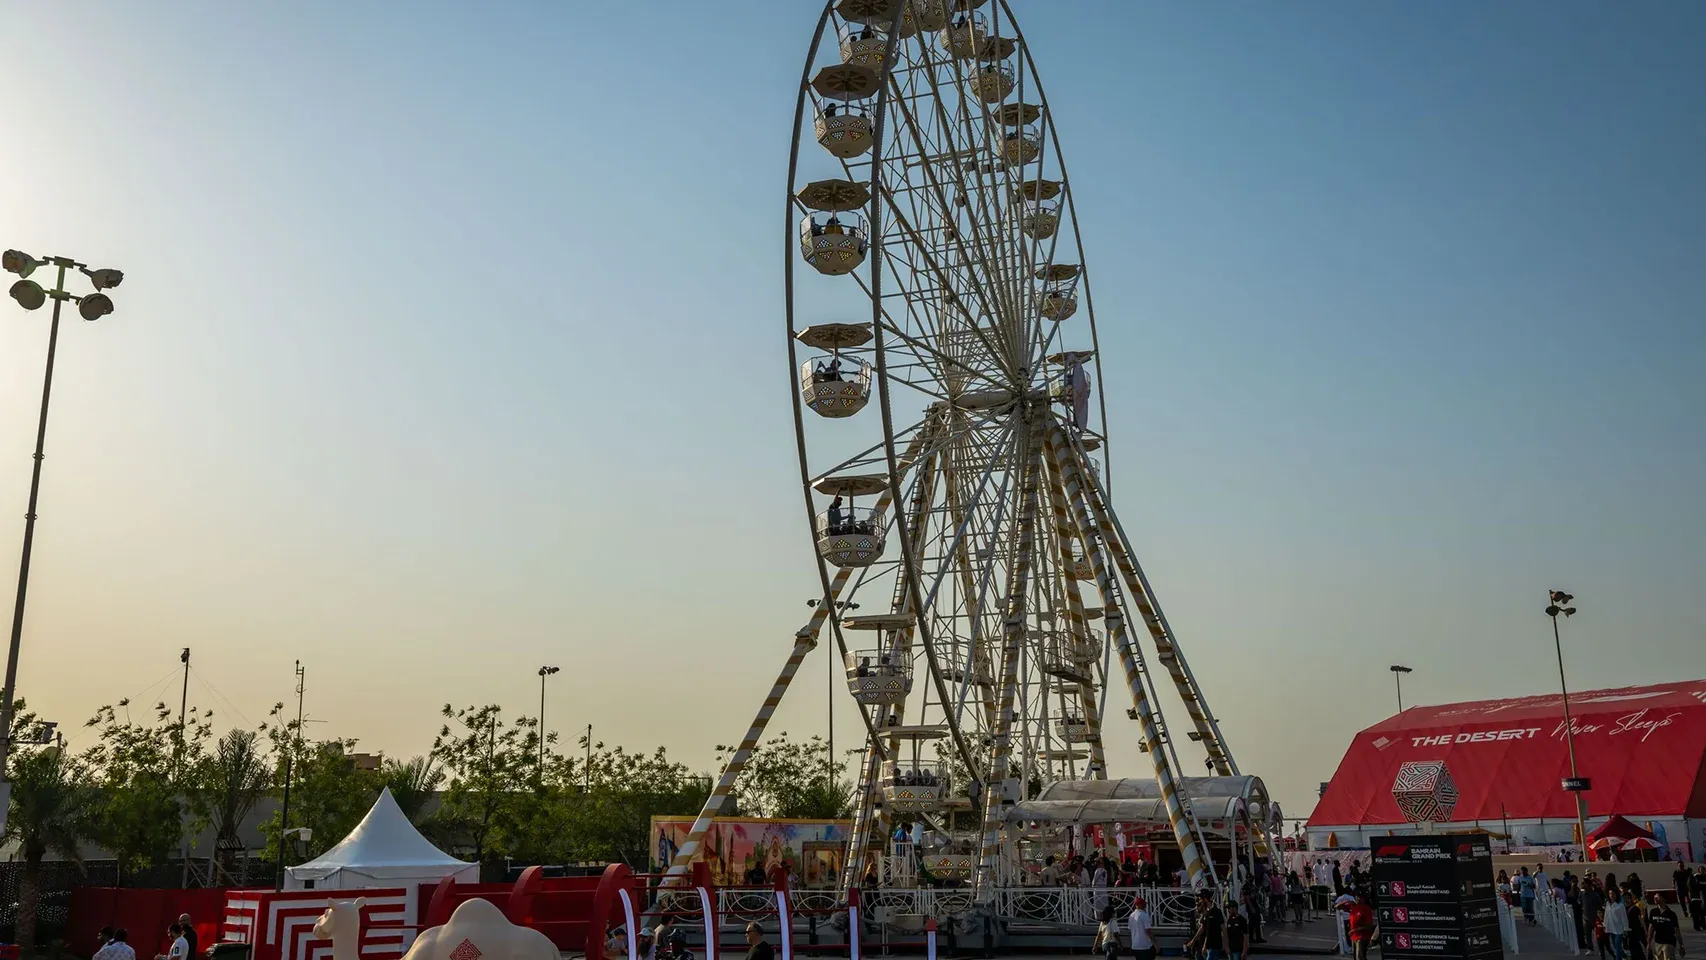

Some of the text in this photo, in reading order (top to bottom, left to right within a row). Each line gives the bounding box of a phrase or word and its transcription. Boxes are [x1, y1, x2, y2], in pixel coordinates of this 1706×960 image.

[1412, 708, 1682, 748] THE DESERT Never Sleeps
